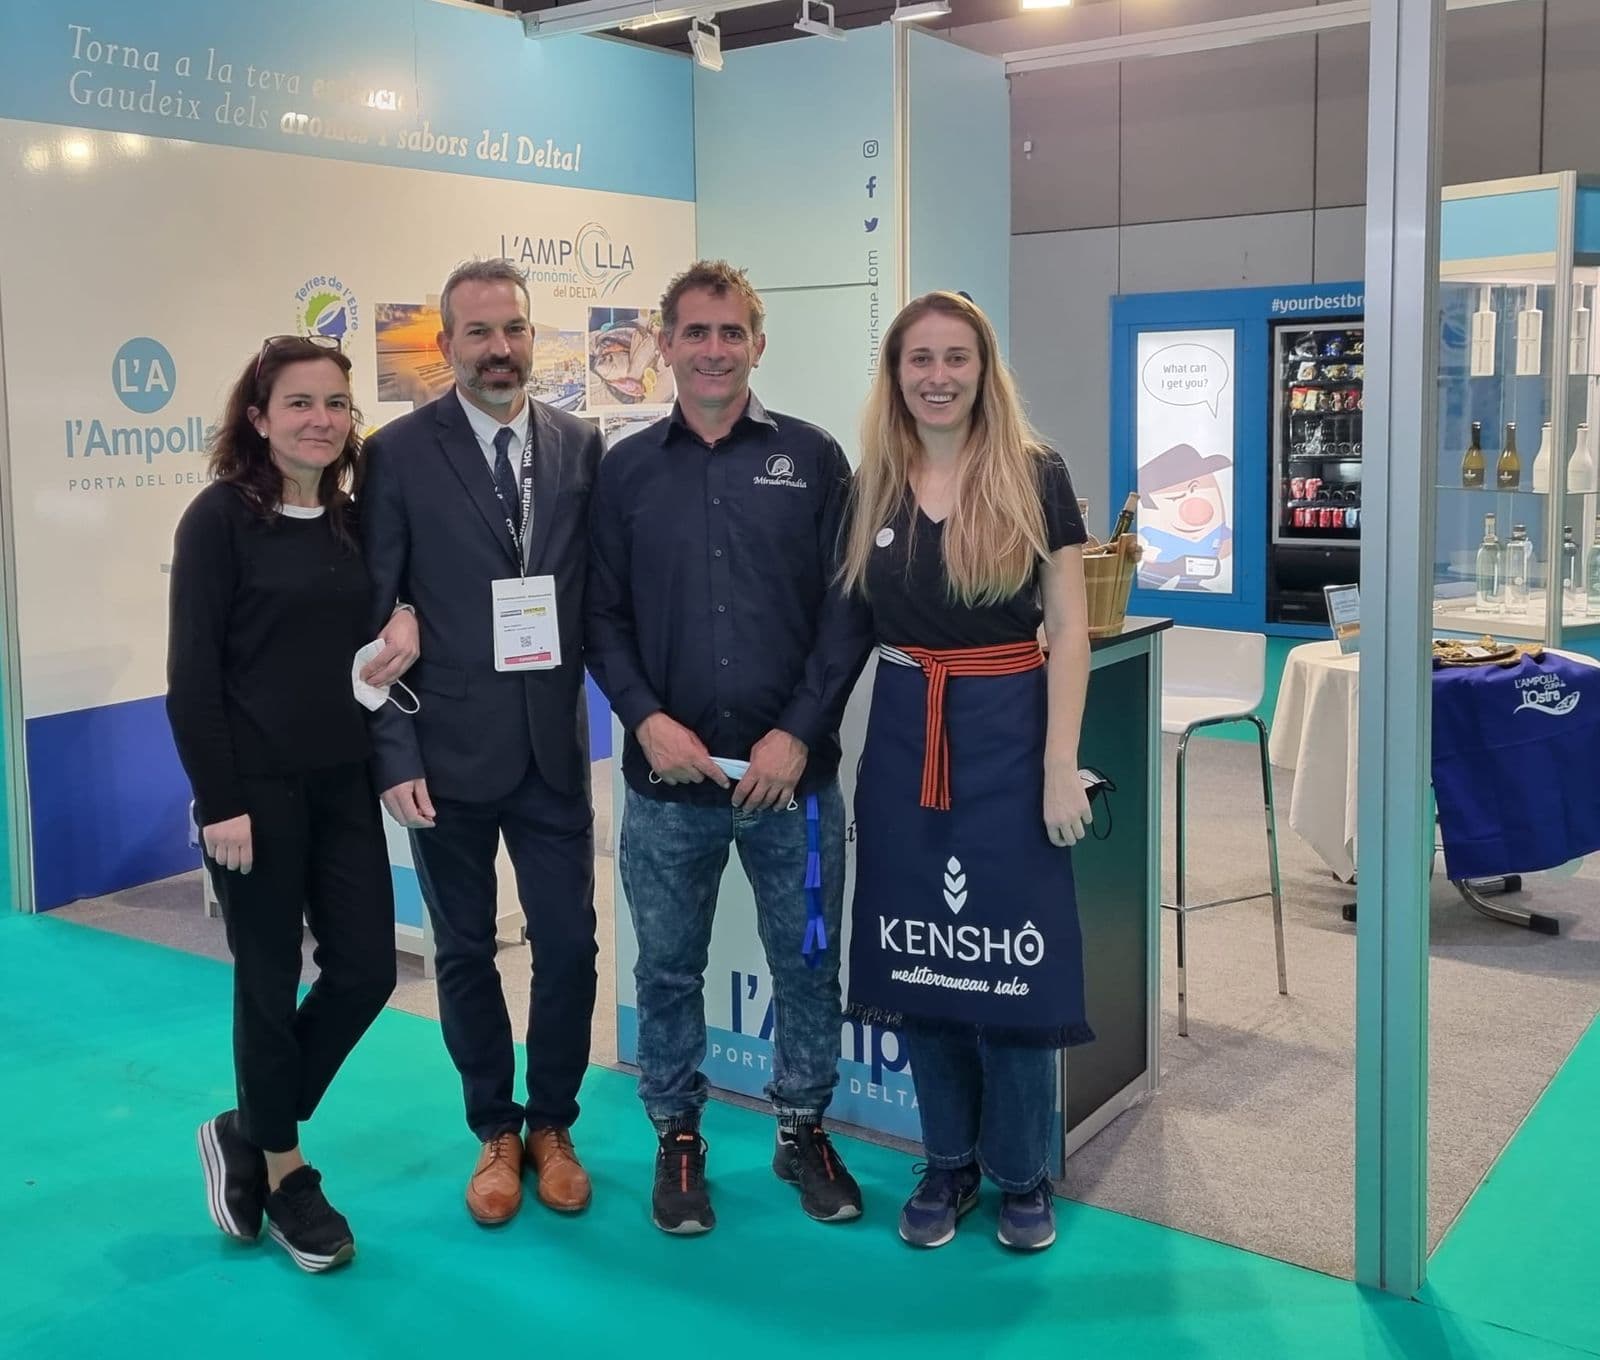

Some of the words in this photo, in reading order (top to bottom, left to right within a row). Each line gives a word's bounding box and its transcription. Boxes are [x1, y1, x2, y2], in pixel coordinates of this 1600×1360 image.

[68, 24, 159, 72] Torna
[175, 55, 191, 77] a
[205, 48, 232, 84] la
[247, 64, 300, 95] teva
[69, 70, 201, 120] Gaudeix
[215, 91, 269, 129] dels
[397, 120, 467, 158] sabors
[476, 129, 509, 162] del
[516, 135, 581, 173] Delta!
[295, 275, 327, 302] Terres
[328, 275, 343, 292] de
[553, 285, 567, 298] del
[569, 286, 598, 299] DELTA
[1271, 294, 1364, 314] #yourbestbr
[119, 358, 169, 393] L'A
[1189, 364, 1207, 373] can
[1166, 378, 1183, 390] get
[1184, 377, 1209, 390] you?
[69, 475, 126, 491] PORTA
[136, 474, 166, 487] DEL
[175, 472, 205, 485] DEL
[879, 915, 1045, 967] KENSHÔ
[994, 976, 1030, 996] sake
[712, 1043, 773, 1073] PORT
